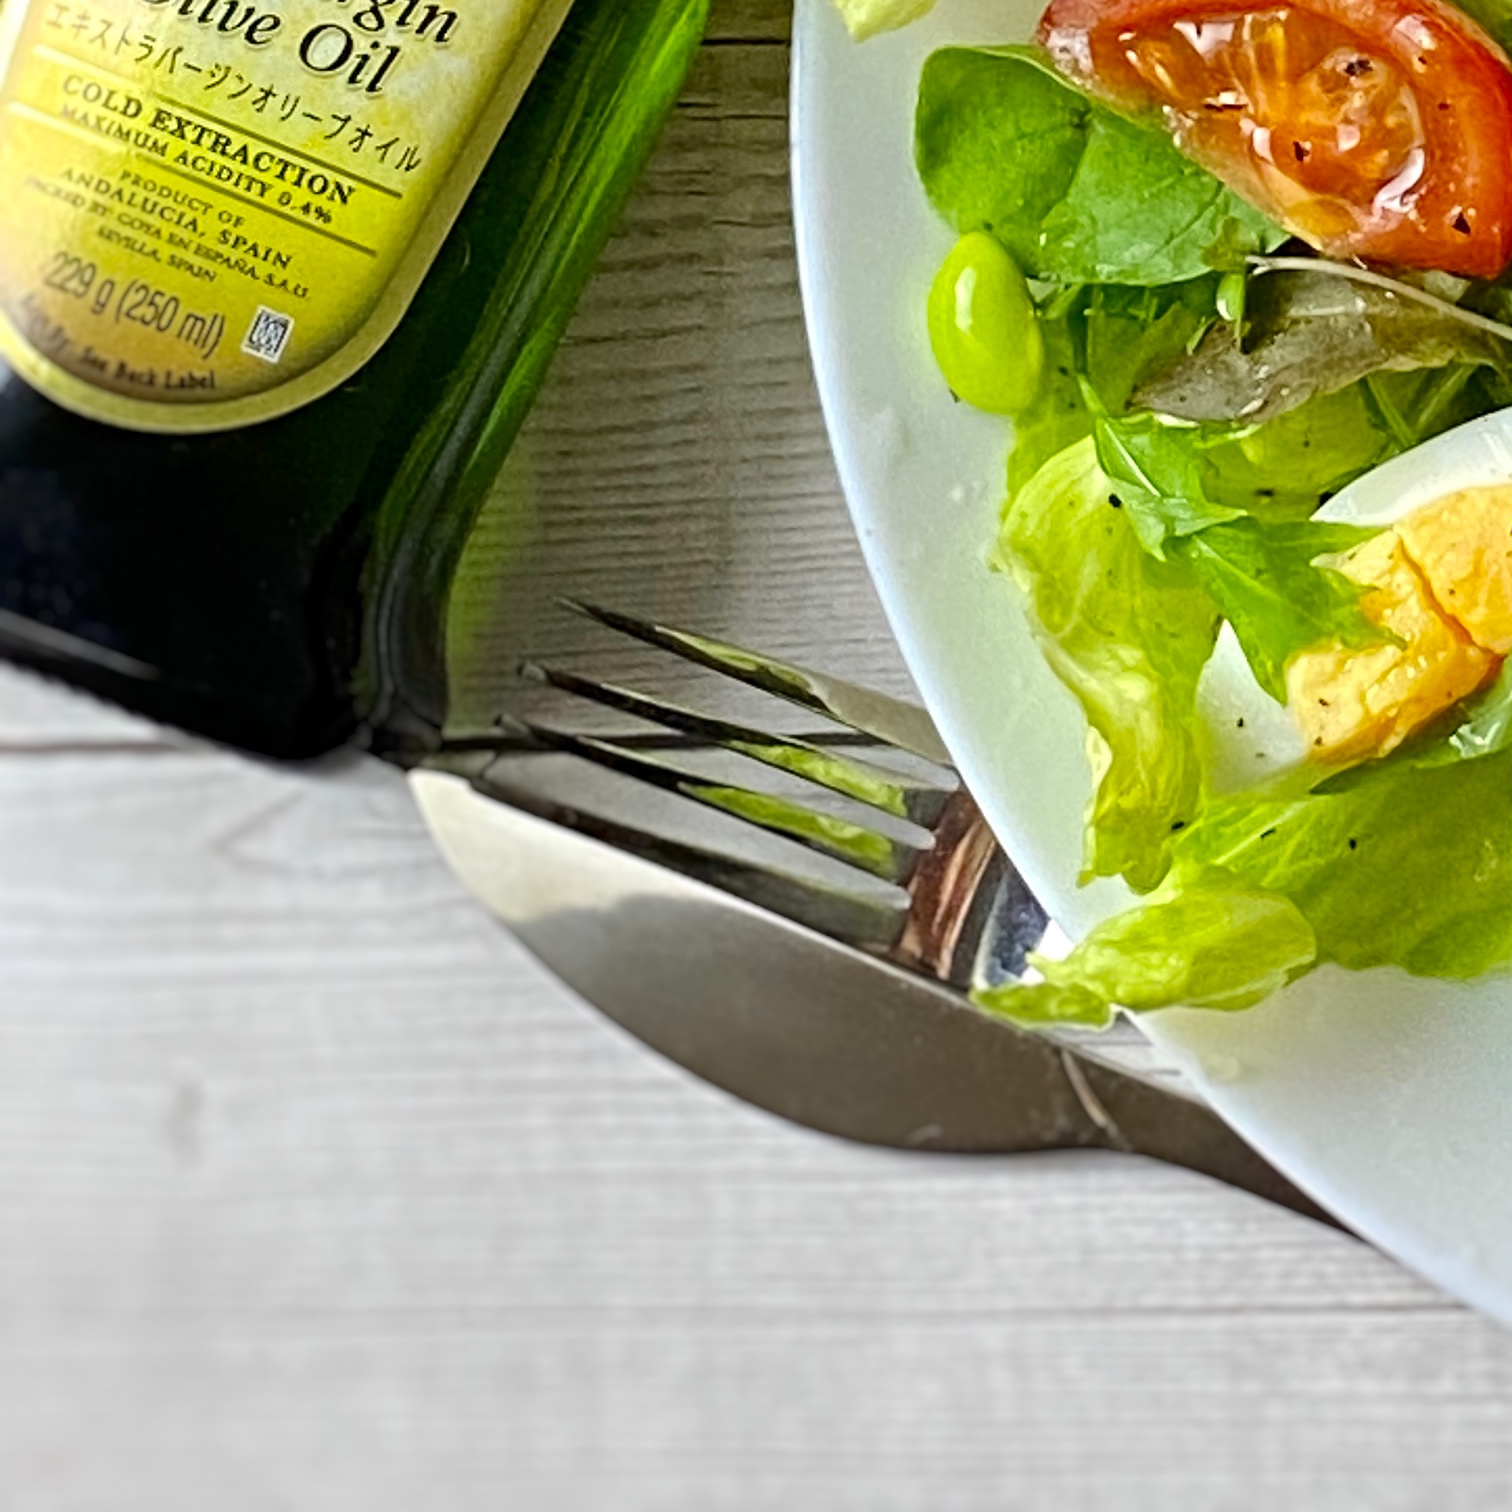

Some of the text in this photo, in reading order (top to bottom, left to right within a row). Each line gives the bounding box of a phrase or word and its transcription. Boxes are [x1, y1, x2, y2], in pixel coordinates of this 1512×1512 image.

[299, 24, 401, 93] Oil
[58, 104, 169, 157] MAXIMUM
[173, 142, 272, 199] ACIDITY
[62, 74, 356, 206] COLD EXTRACTION
[121, 169, 245, 228] PRODUCT OF
[167, 231, 191, 250] EN
[167, 253, 217, 283] SPAIN
[217, 228, 293, 270] SPAIN
[43, 251, 97, 298] 229
[91, 279, 115, 315] g
[114, 278, 179, 333] (250
[177, 313, 226, 360] ml)
